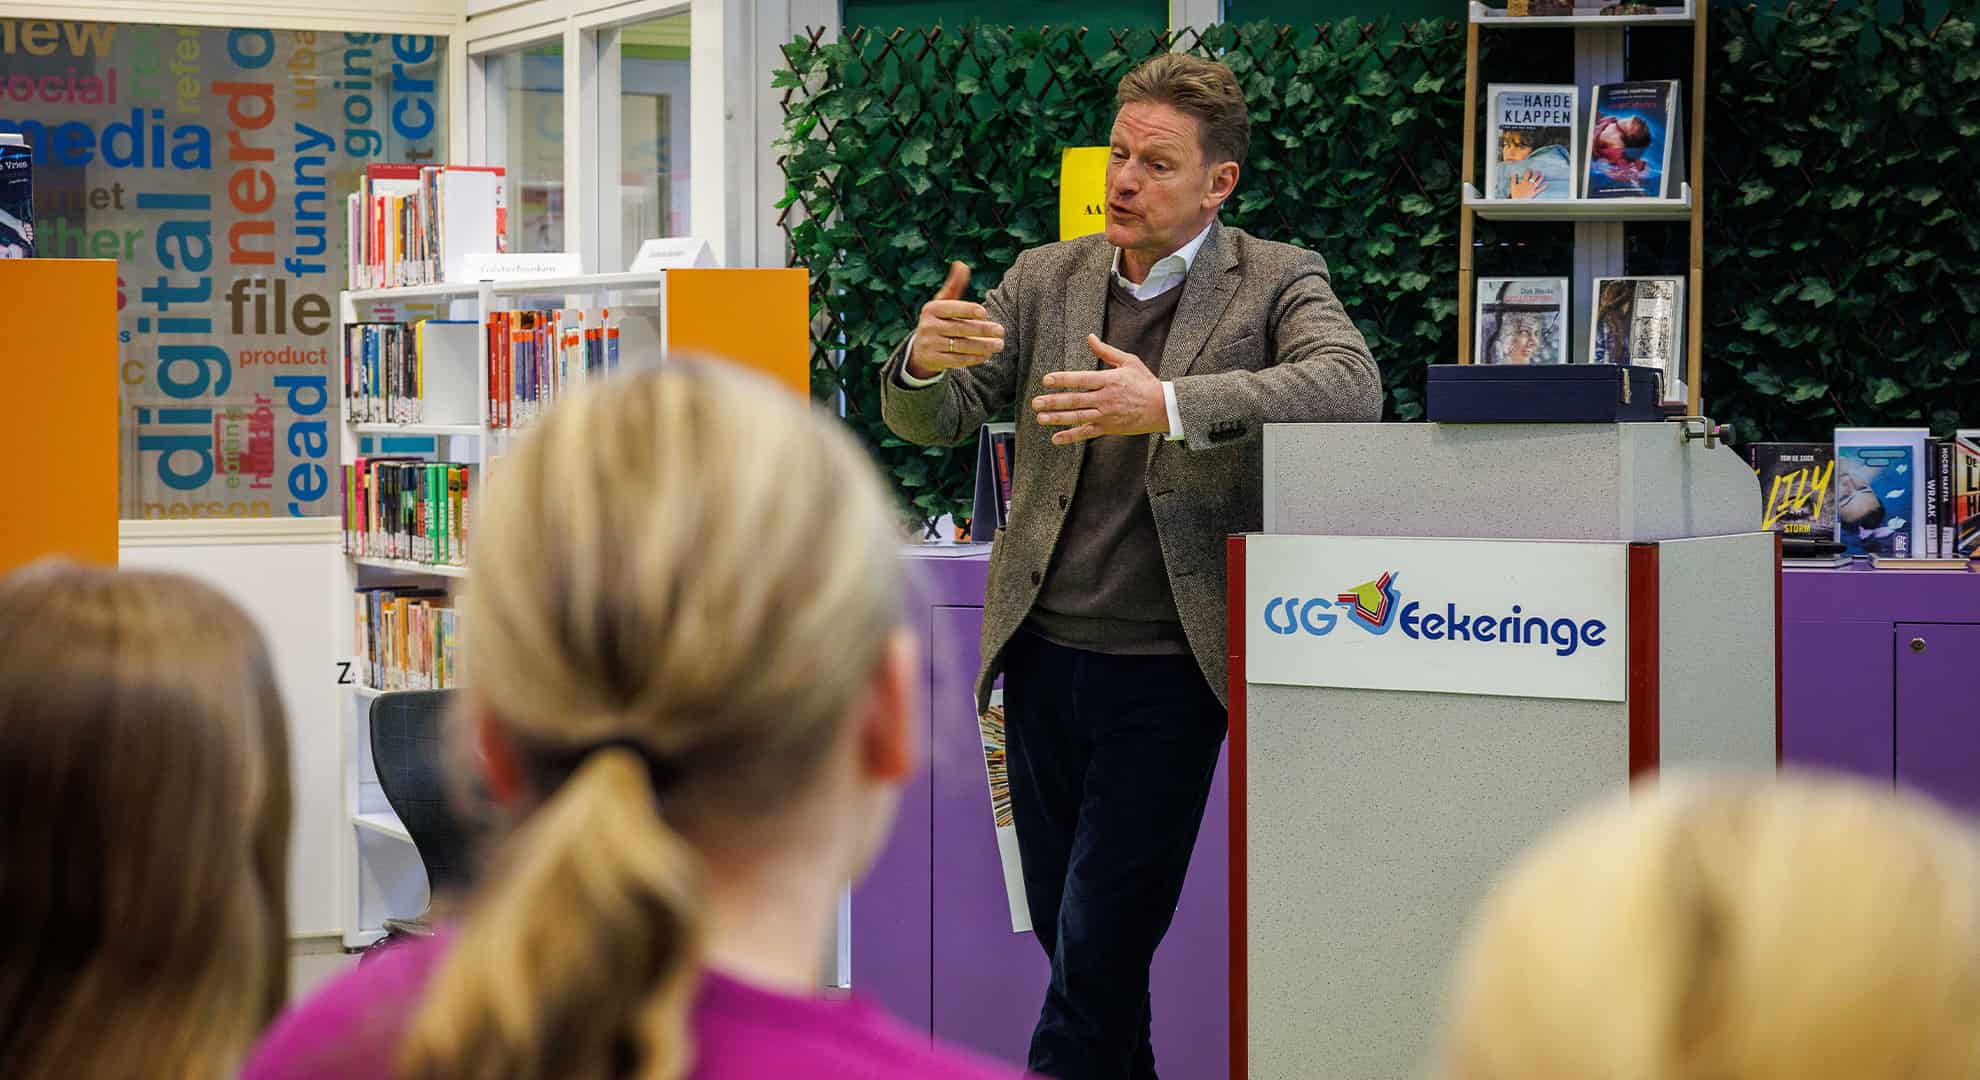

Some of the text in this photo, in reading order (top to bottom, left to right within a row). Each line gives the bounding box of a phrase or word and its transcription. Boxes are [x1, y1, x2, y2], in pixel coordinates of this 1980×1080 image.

[0, 66, 118, 105] ocial
[1524, 95, 1571, 109] HARDE
[1505, 110, 1571, 124] KLAPPEN
[211, 80, 276, 266] nerd
[285, 122, 336, 278] funny
[225, 278, 331, 337] file
[135, 192, 232, 491] digital
[239, 346, 328, 368] product
[273, 375, 329, 518] read
[1762, 459, 1835, 531] LILY
[1927, 479, 1937, 518] WRAAK
[1264, 596, 1607, 657] CSG Eekeringe
